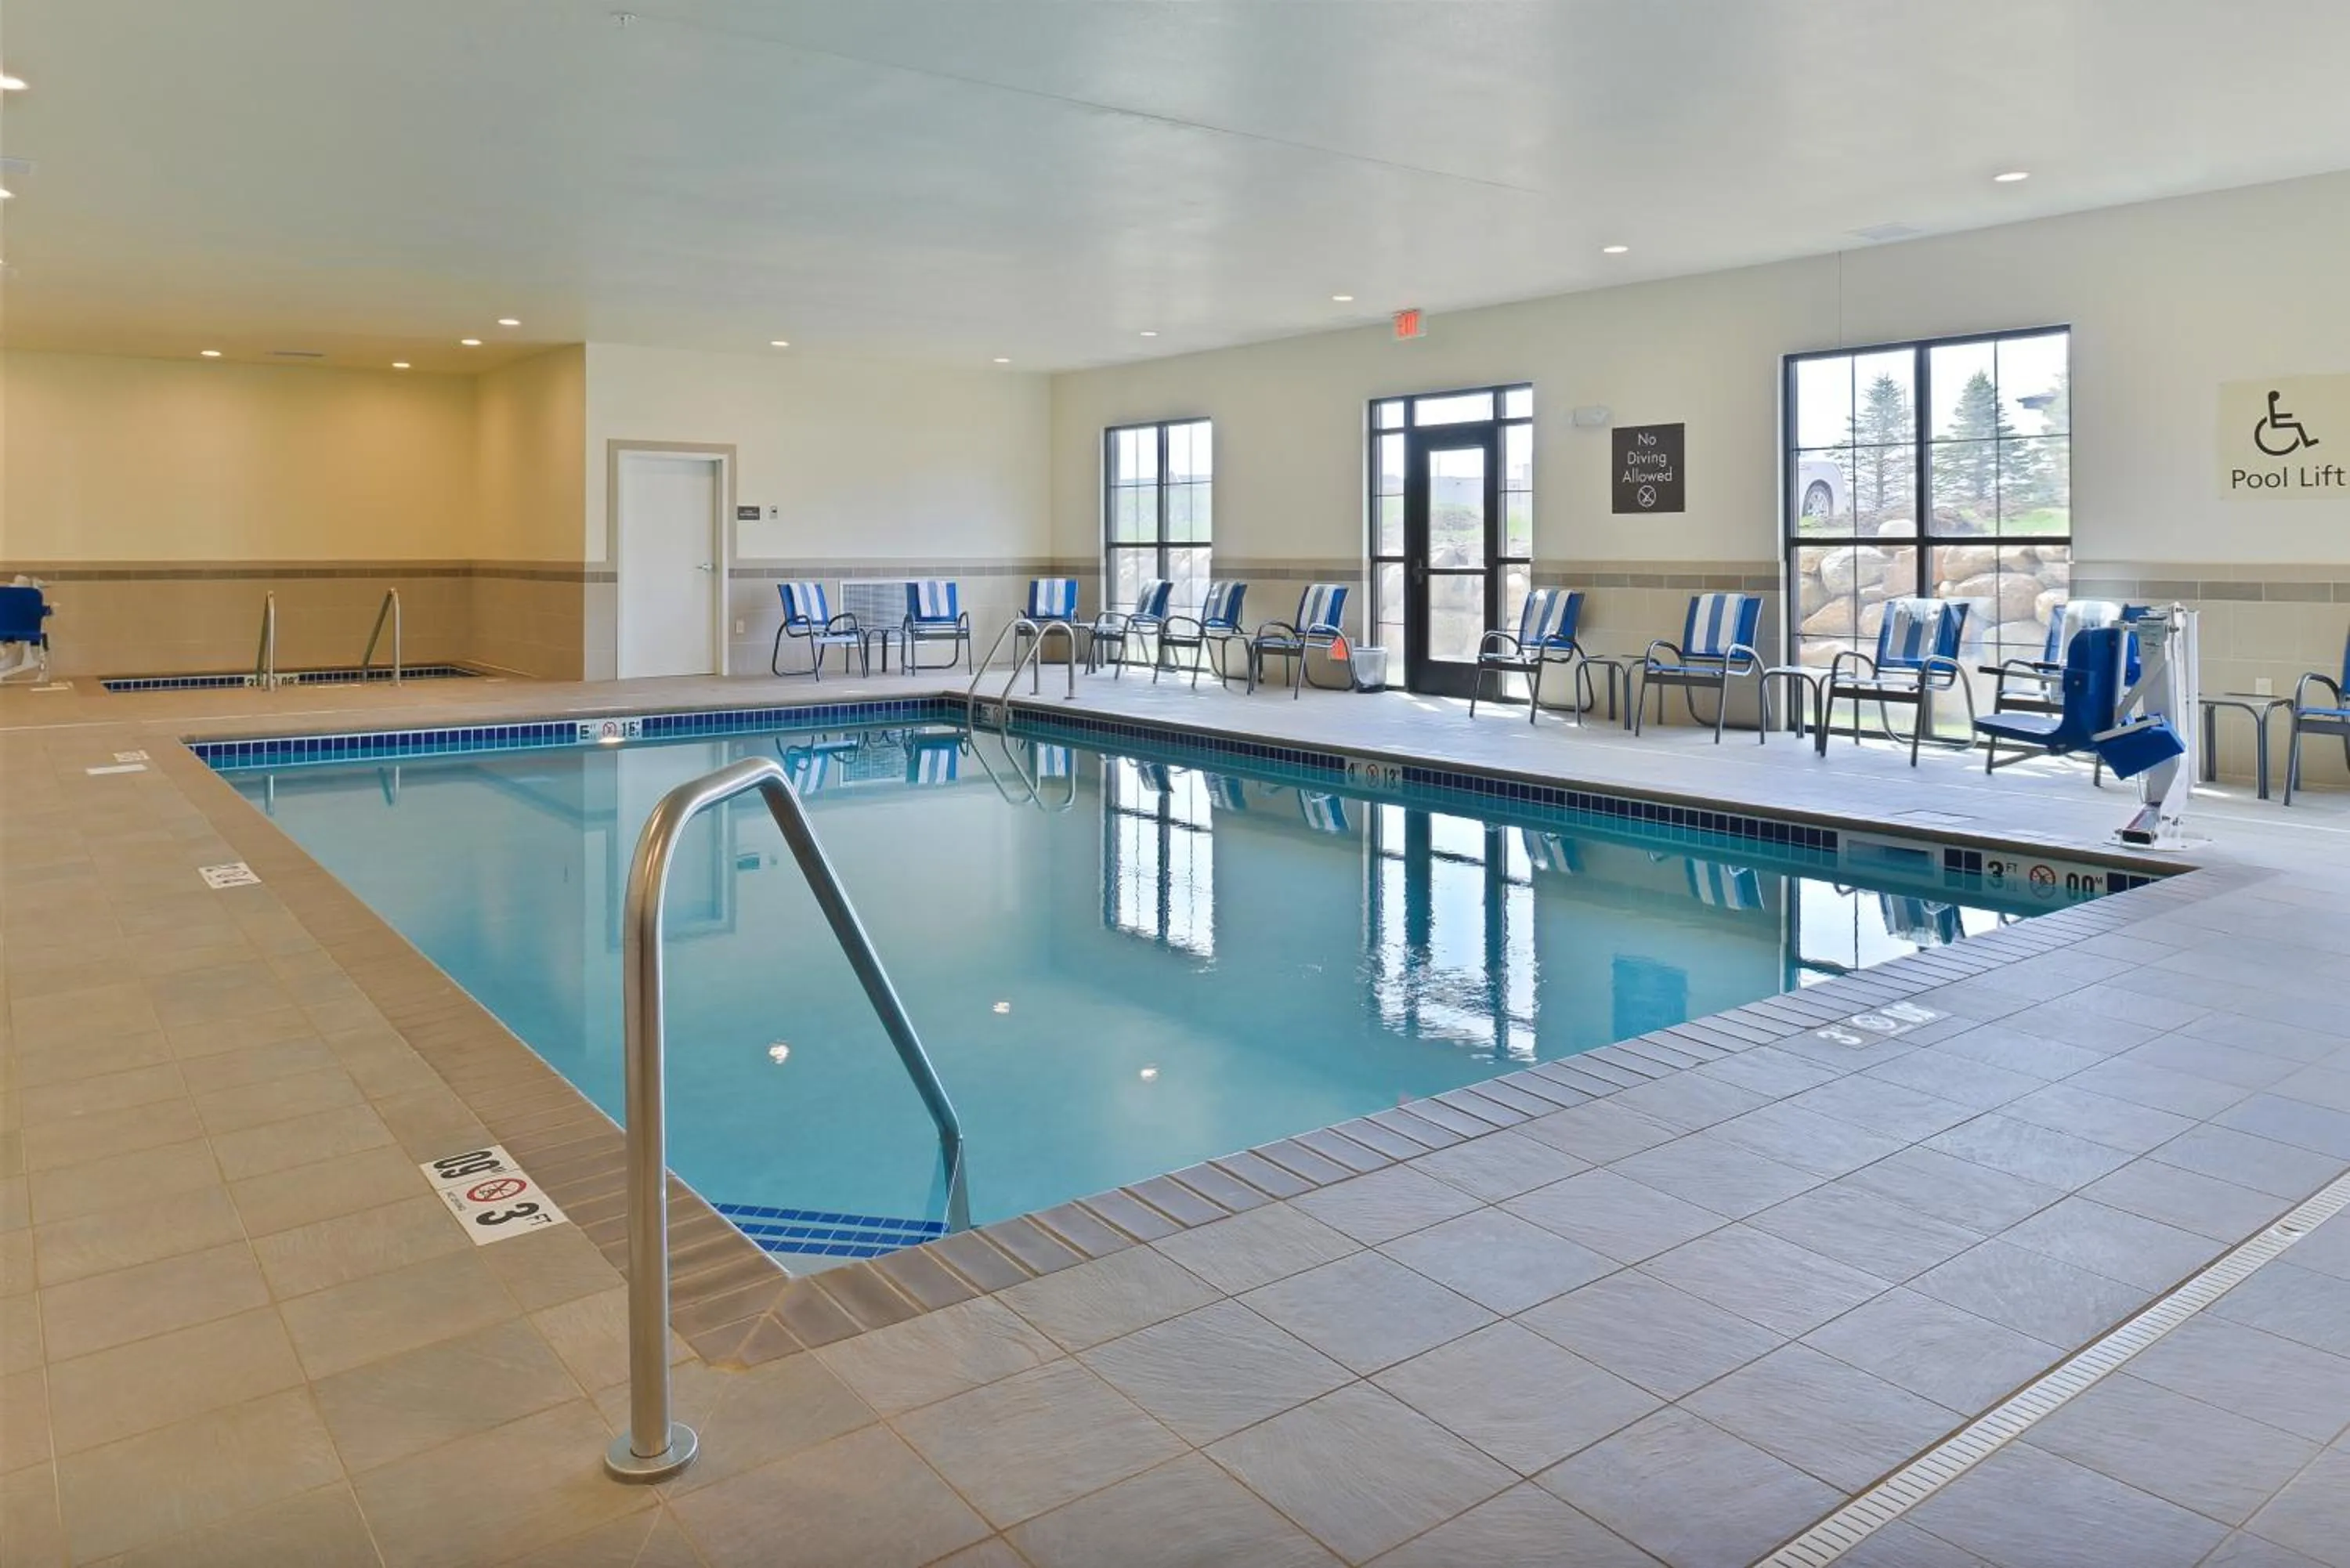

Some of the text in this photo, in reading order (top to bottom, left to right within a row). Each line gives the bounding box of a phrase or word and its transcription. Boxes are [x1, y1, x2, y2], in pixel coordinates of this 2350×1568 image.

[1638, 432, 1657, 446] No
[1628, 450, 1666, 468] Diving
[1622, 466, 1672, 482] Allowed
[2232, 464, 2346, 489] Pool Lift
